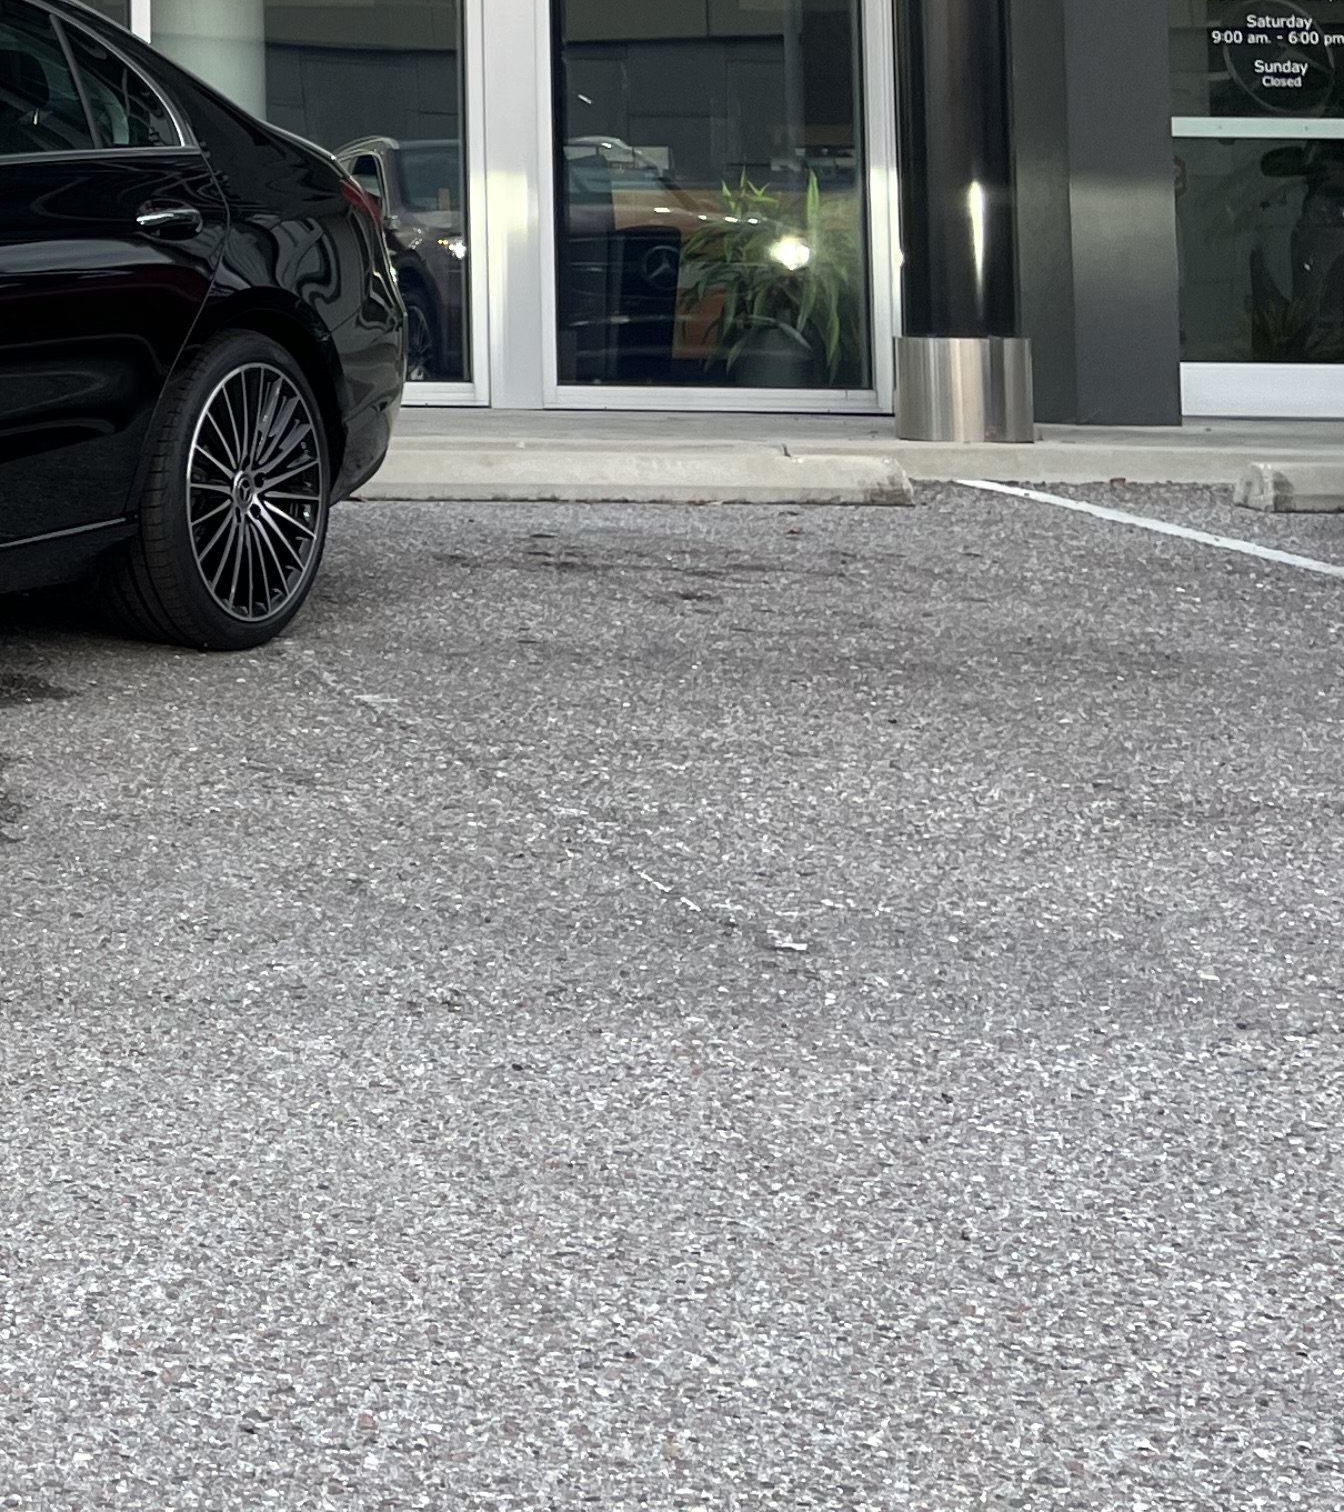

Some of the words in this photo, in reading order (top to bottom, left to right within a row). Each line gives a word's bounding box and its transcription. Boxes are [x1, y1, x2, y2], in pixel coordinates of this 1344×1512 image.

[1246, 13, 1313, 31] Saturday
[1254, 59, 1308, 76] Sunday
[1262, 76, 1303, 88] Closed
